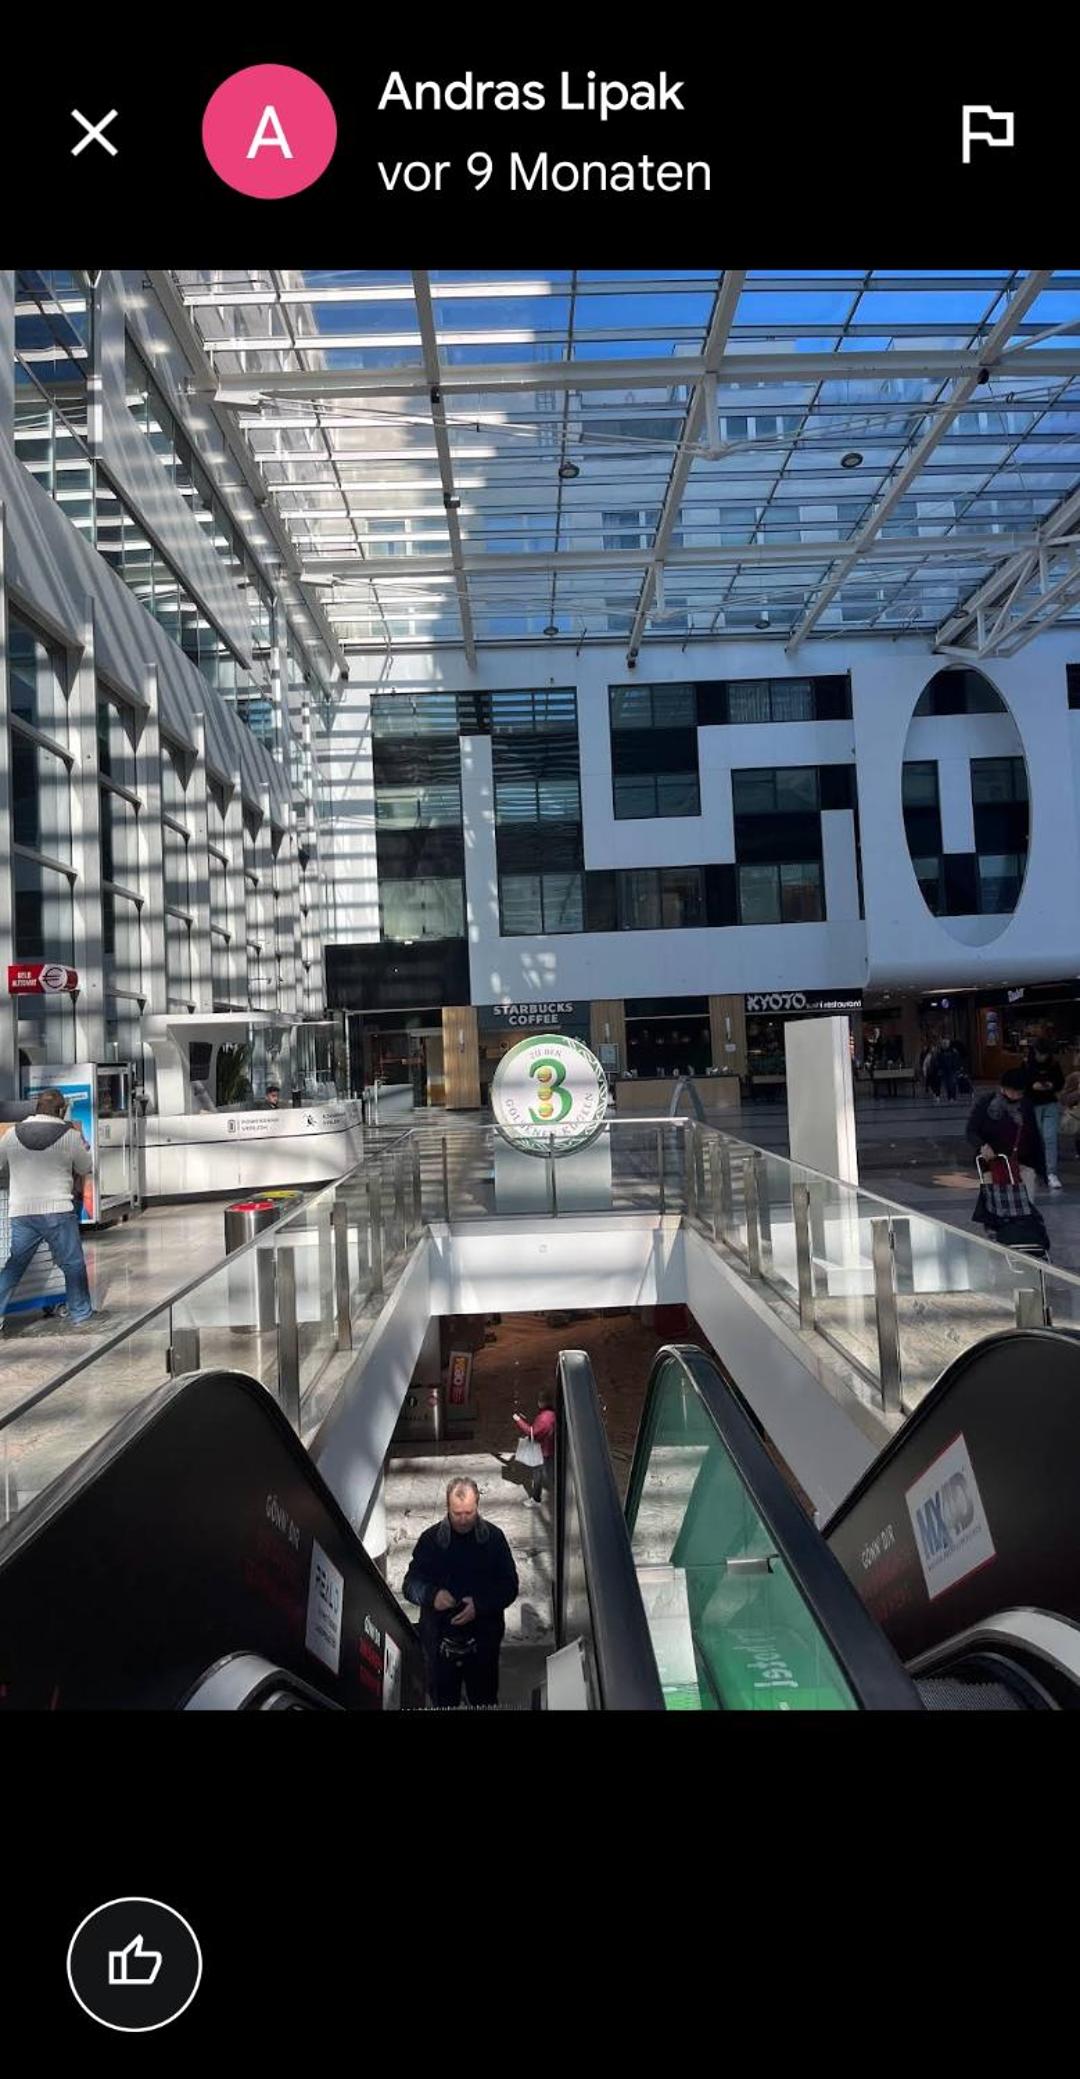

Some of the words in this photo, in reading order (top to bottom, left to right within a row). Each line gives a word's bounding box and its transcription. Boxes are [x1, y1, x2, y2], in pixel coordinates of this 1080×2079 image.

[493, 1002, 574, 1016] STARBUCKS
[746, 991, 806, 1011] KYOTO
[508, 1013, 560, 1026] COFFEE
[528, 1057, 574, 1126] 3
